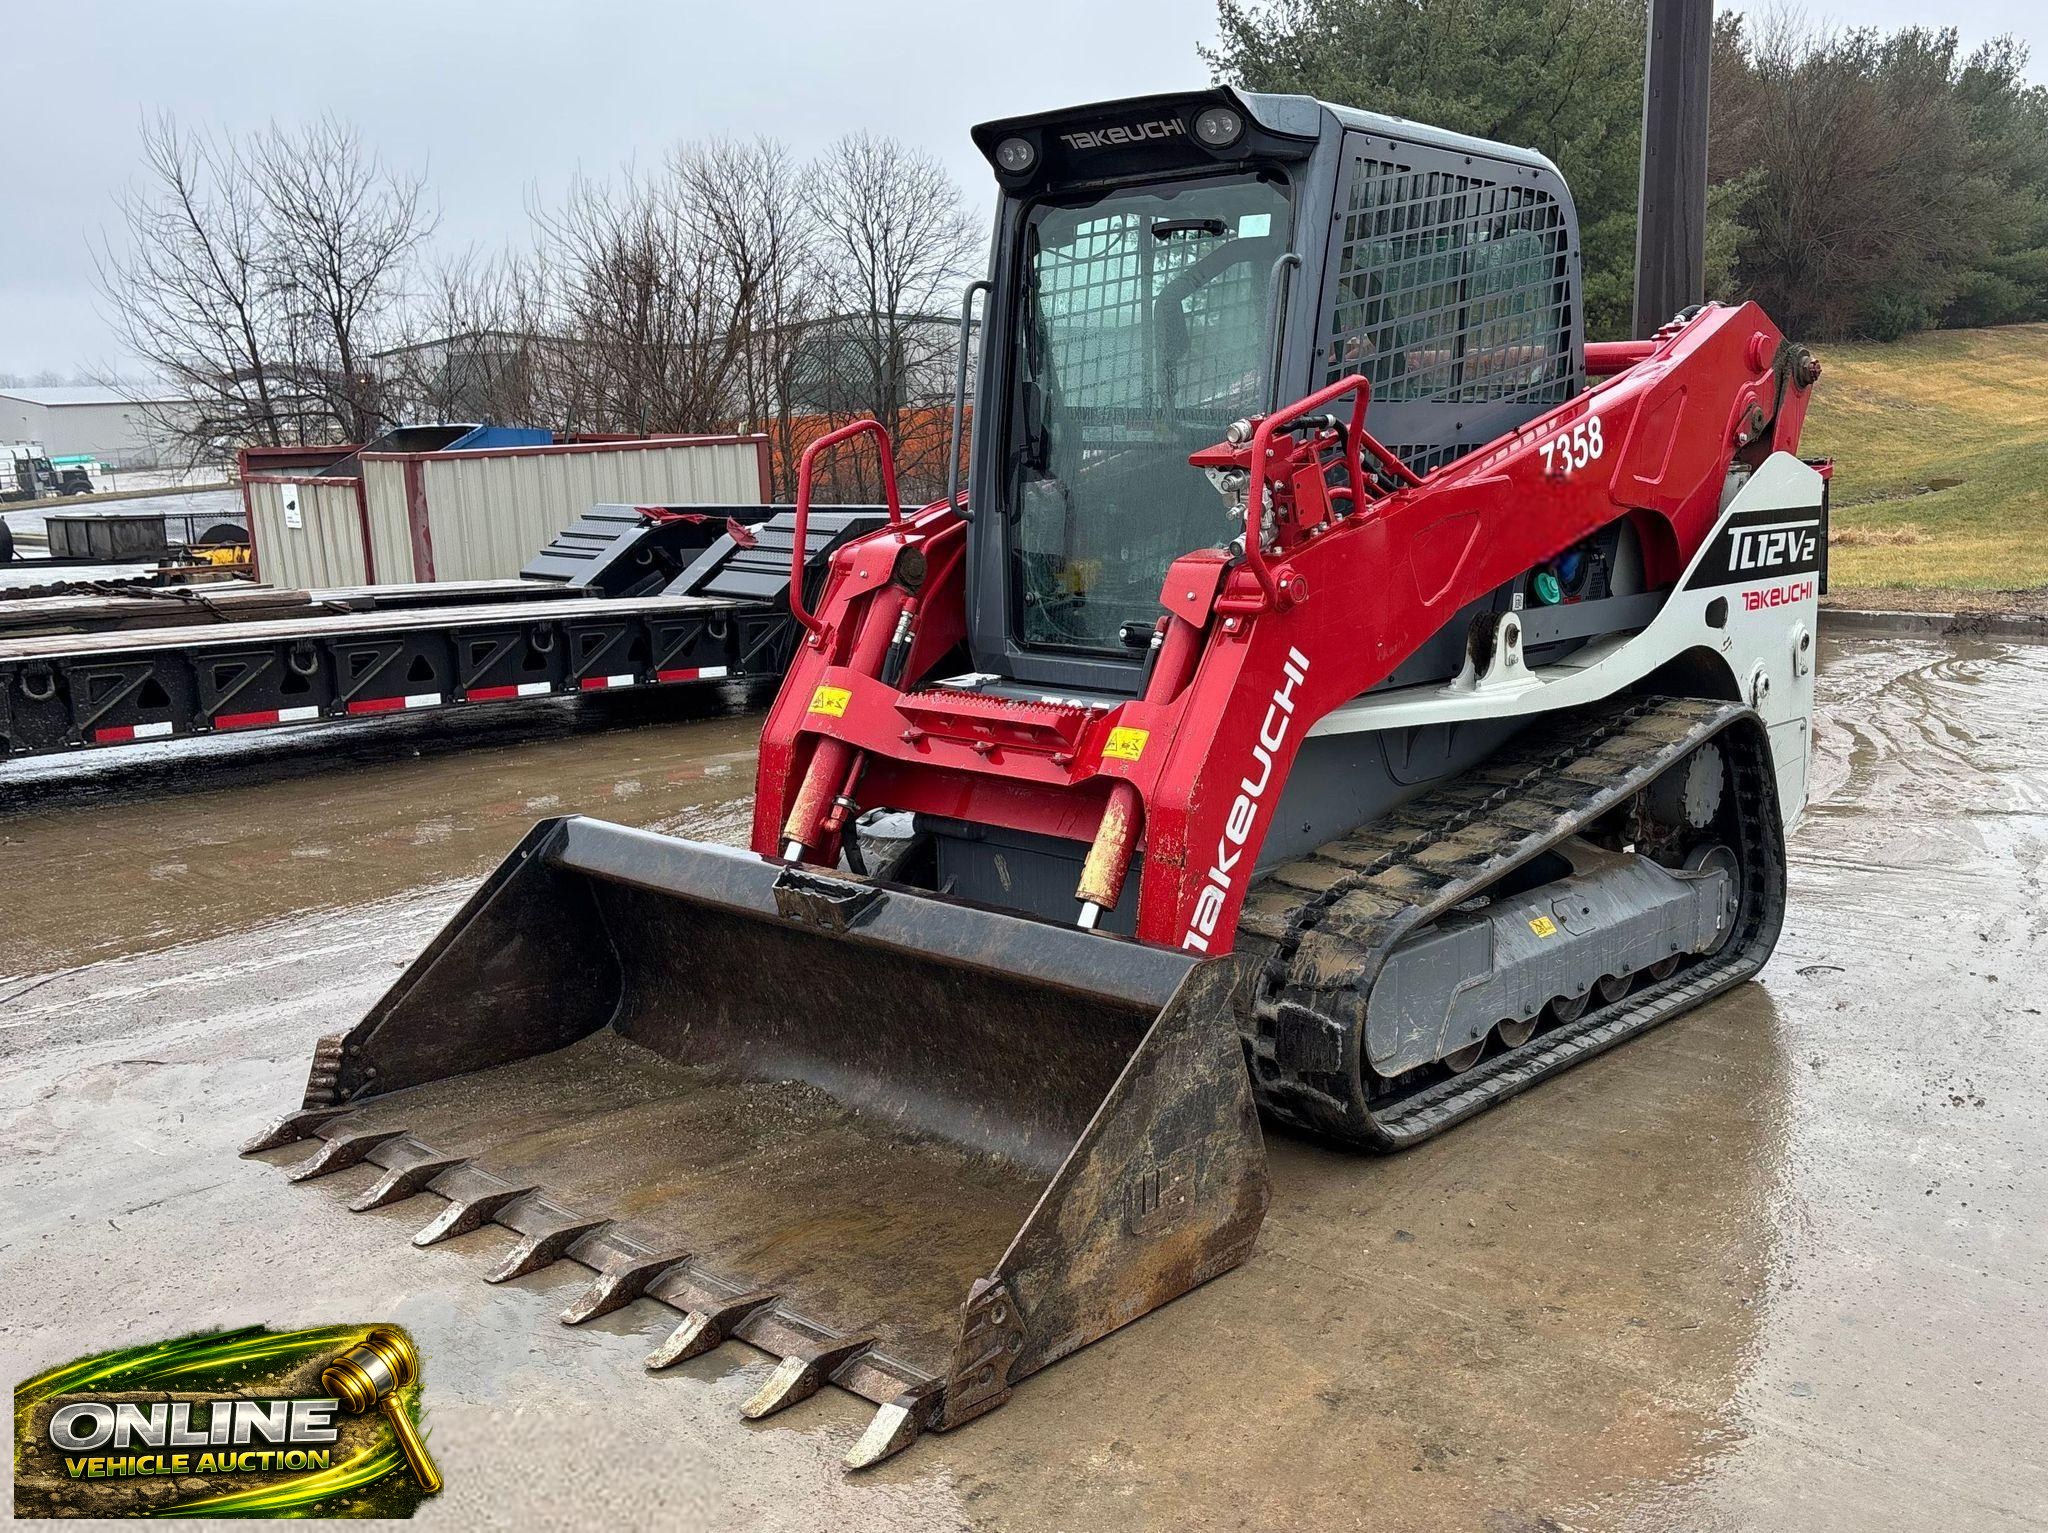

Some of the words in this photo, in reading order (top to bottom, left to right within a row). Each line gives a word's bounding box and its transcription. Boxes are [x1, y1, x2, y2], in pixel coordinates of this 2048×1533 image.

[1060, 118, 1186, 150] TAKEUCHI
[1539, 415, 1604, 474] 7358
[1728, 519, 1820, 572] TL12V2
[1741, 581, 1813, 611] TAKEUCHI
[1182, 645, 1311, 952] TAKEUCHI
